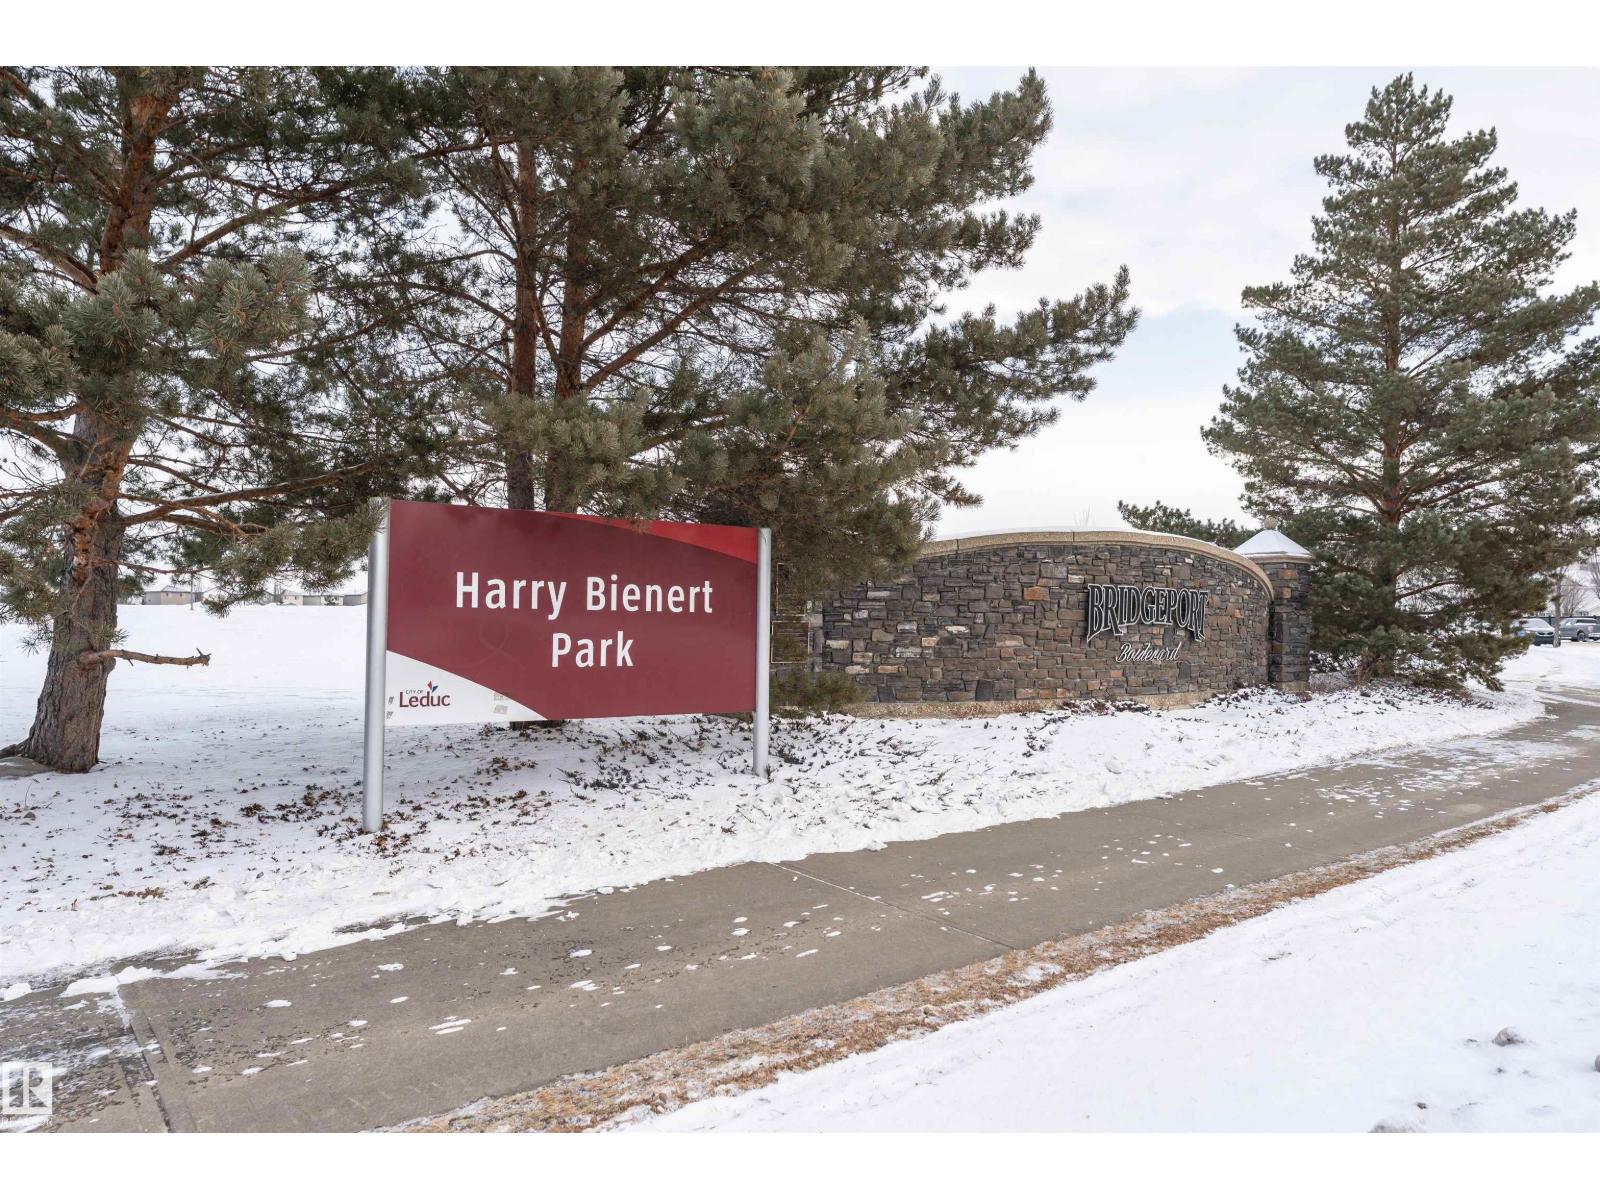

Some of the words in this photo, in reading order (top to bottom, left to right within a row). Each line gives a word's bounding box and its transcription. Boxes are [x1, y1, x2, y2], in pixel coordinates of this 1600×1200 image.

[456, 571, 567, 620] Harry
[586, 574, 713, 613] Bienert
[1087, 584, 1208, 642] BRIDGEPORT
[551, 630, 634, 668] Park
[399, 691, 451, 707] Leduc
